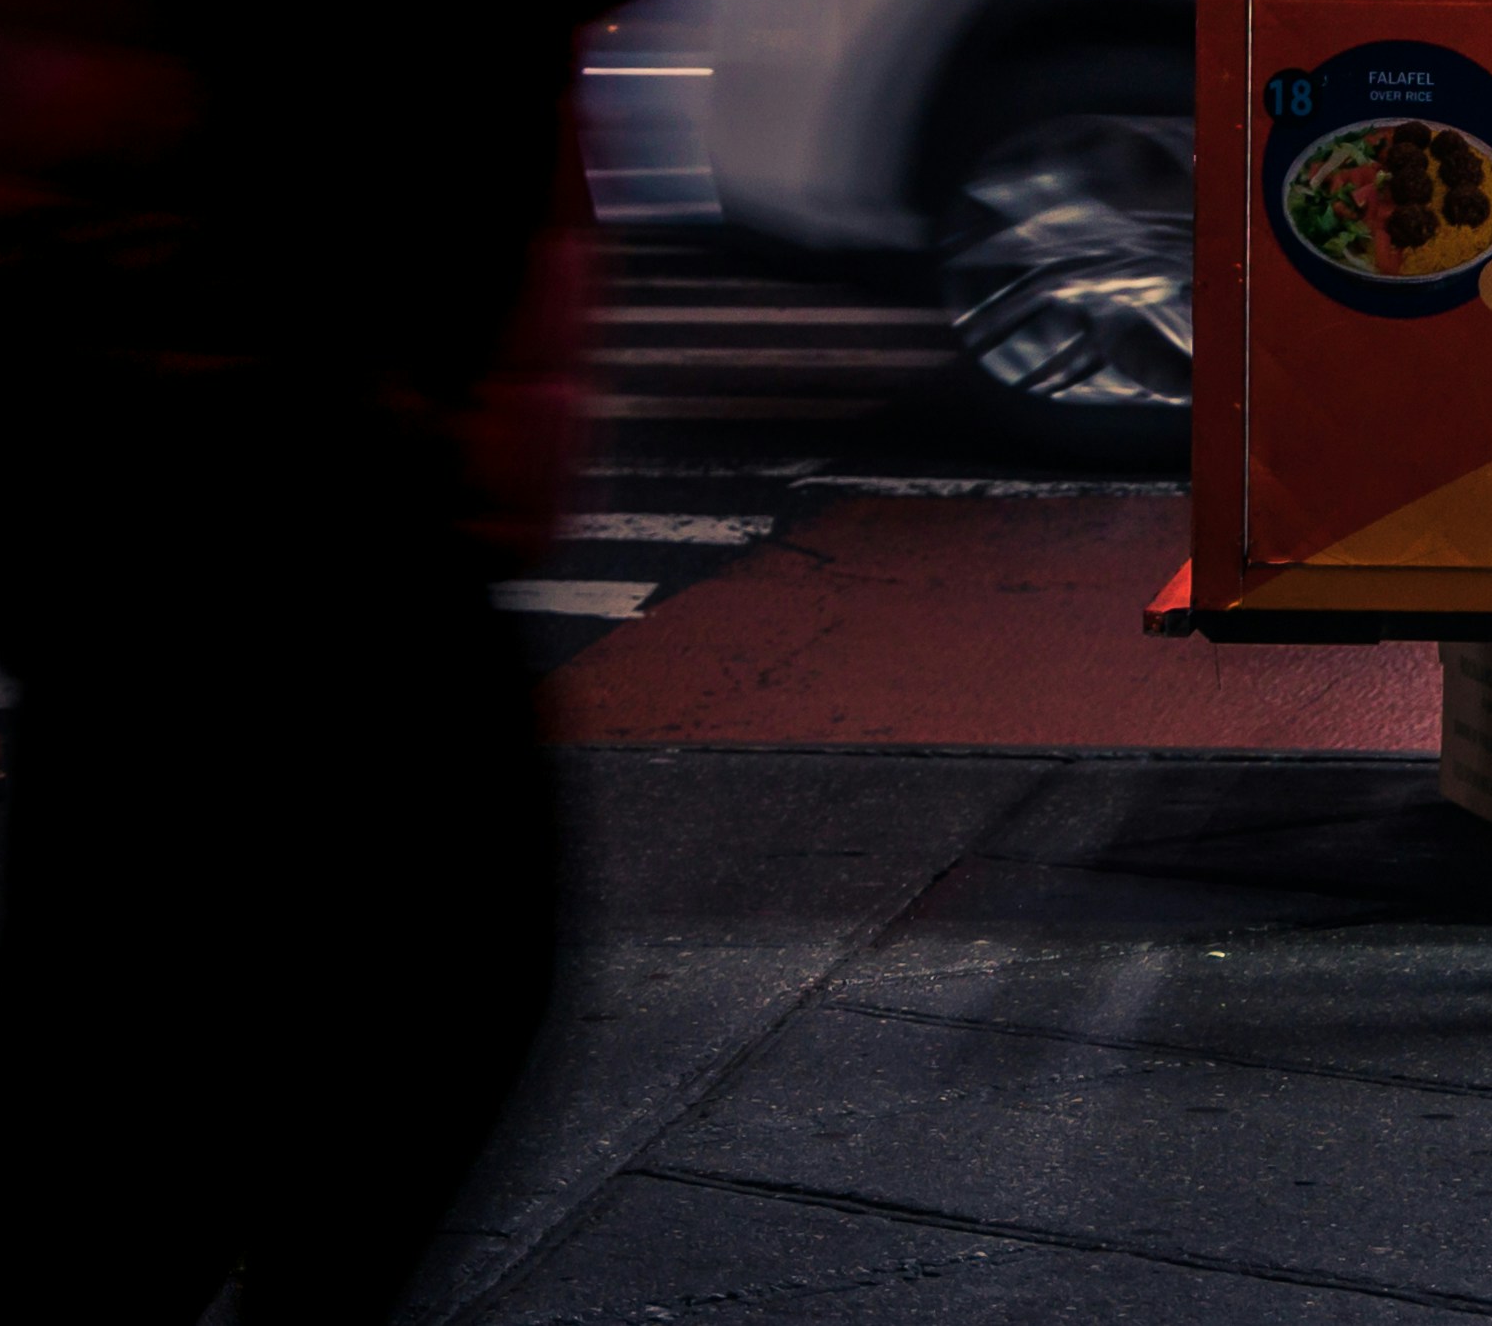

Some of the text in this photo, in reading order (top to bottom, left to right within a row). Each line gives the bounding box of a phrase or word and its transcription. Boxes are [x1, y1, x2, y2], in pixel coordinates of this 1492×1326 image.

[1368, 70, 1436, 87] FALAFEL
[1268, 77, 1315, 118] 18
[1369, 90, 1434, 103] OVER RICE
